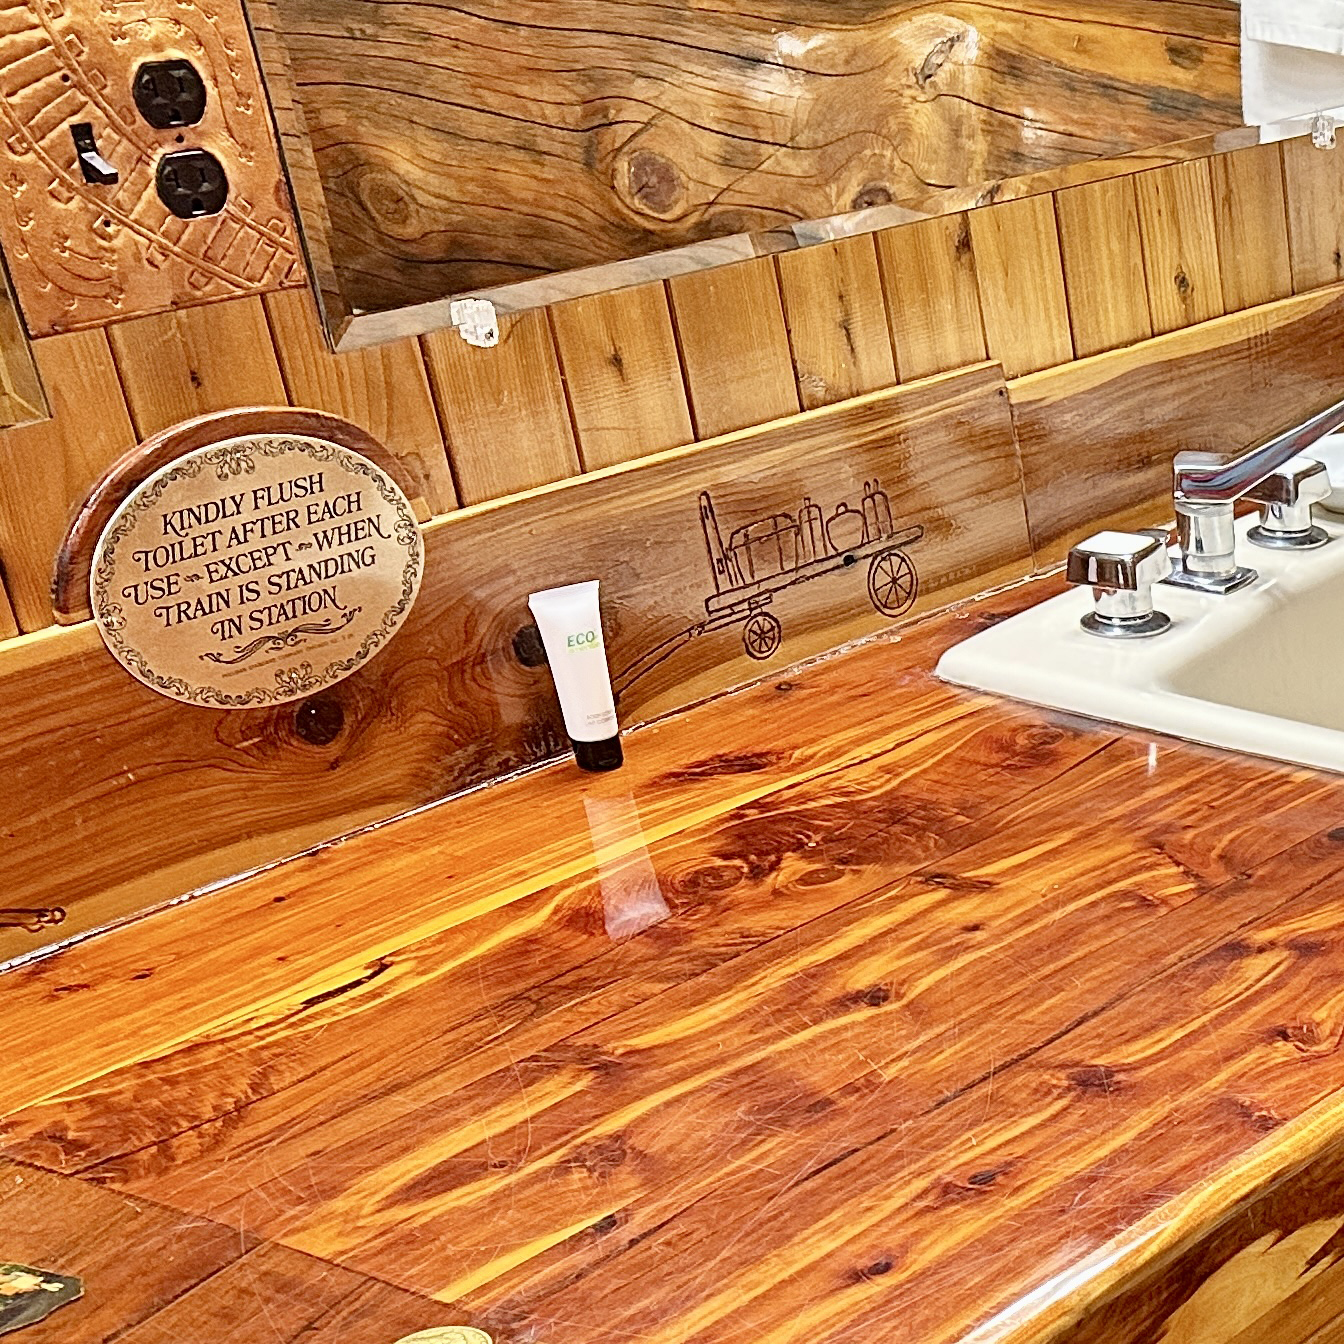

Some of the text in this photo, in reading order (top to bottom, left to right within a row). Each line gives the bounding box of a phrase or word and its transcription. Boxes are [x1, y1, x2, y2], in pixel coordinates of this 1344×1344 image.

[132, 491, 363, 573] TOILET AFTER EACH
[162, 472, 325, 539] KINDLY FLUSH
[121, 514, 391, 606] USE EXCEPT WHEN
[154, 546, 376, 628] TRAIN IS STANDING
[211, 586, 347, 641] IN STATION
[567, 630, 595, 648] ECO
